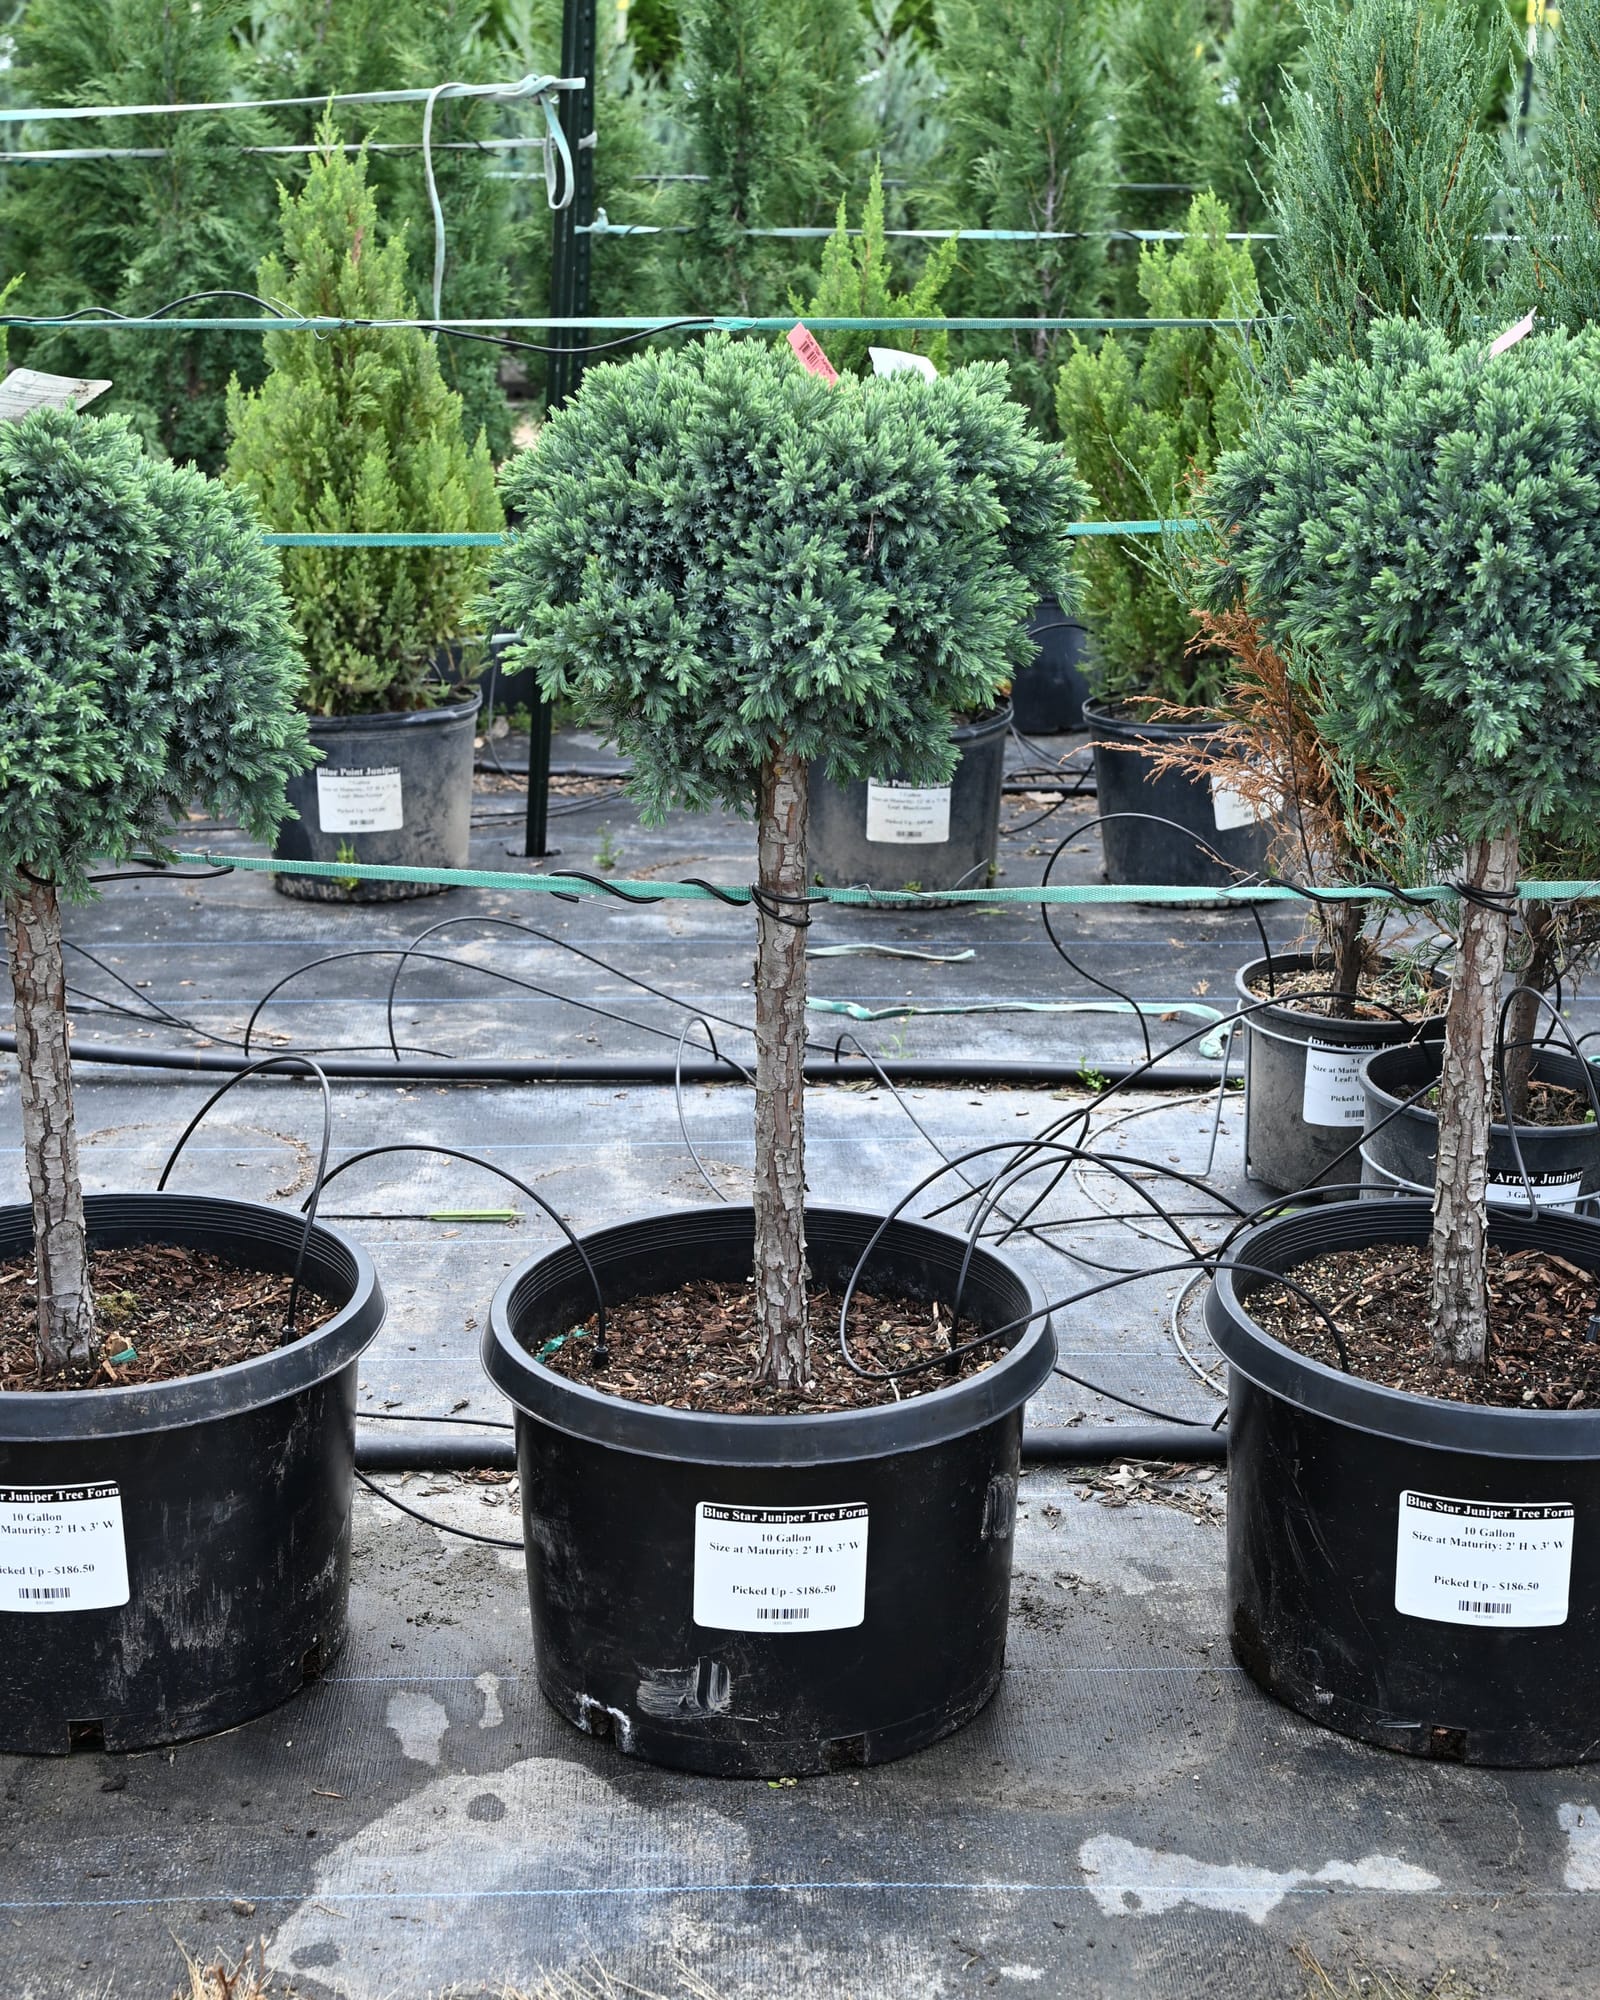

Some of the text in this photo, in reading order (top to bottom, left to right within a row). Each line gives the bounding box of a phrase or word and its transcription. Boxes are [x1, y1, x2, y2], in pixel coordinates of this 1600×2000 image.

[1312, 1065, 1326, 1073] Size
[1540, 1170, 1583, 1185] Juniper
[8, 1491, 54, 1504] Juniper
[55, 1490, 84, 1500] Tree
[87, 1487, 119, 1498] Form
[1407, 1495, 1574, 1519] Blue Star Juniper Tree Form
[12, 1512, 62, 1521] 10 Gallon
[703, 1506, 868, 1524] Blue Star Juniper Tree Form
[0, 1524, 51, 1536] Maturity:
[55, 1525, 64, 1534] 2'
[68, 1524, 77, 1533] H
[90, 1521, 99, 1531] 3'
[103, 1520, 114, 1529] W
[1464, 1526, 1515, 1538] 10 Gallon
[761, 1533, 812, 1542] 10 Gallon
[1411, 1530, 1433, 1543] Size
[1450, 1537, 1502, 1552] Maturity:
[1506, 1542, 1516, 1551] 2'
[1519, 1542, 1528, 1551] H
[1540, 1541, 1550, 1551] 3'
[1553, 1540, 1564, 1549] W
[709, 1541, 730, 1553] Size
[747, 1545, 799, 1557] Maturity:
[802, 1546, 812, 1555] 2'
[815, 1545, 824, 1554] H
[836, 1543, 846, 1552] 3'
[849, 1541, 859, 1550] W
[0, 1565, 26, 1575] icked
[29, 1566, 45, 1577] Up
[54, 1563, 95, 1575] $186.50
[1434, 1575, 1469, 1588] Picked
[1473, 1580, 1489, 1591] Up
[1499, 1582, 1540, 1591] $186.50
[732, 1584, 767, 1596] Picked
[771, 1587, 787, 1598] Up
[796, 1584, 836, 1596] $186.50
